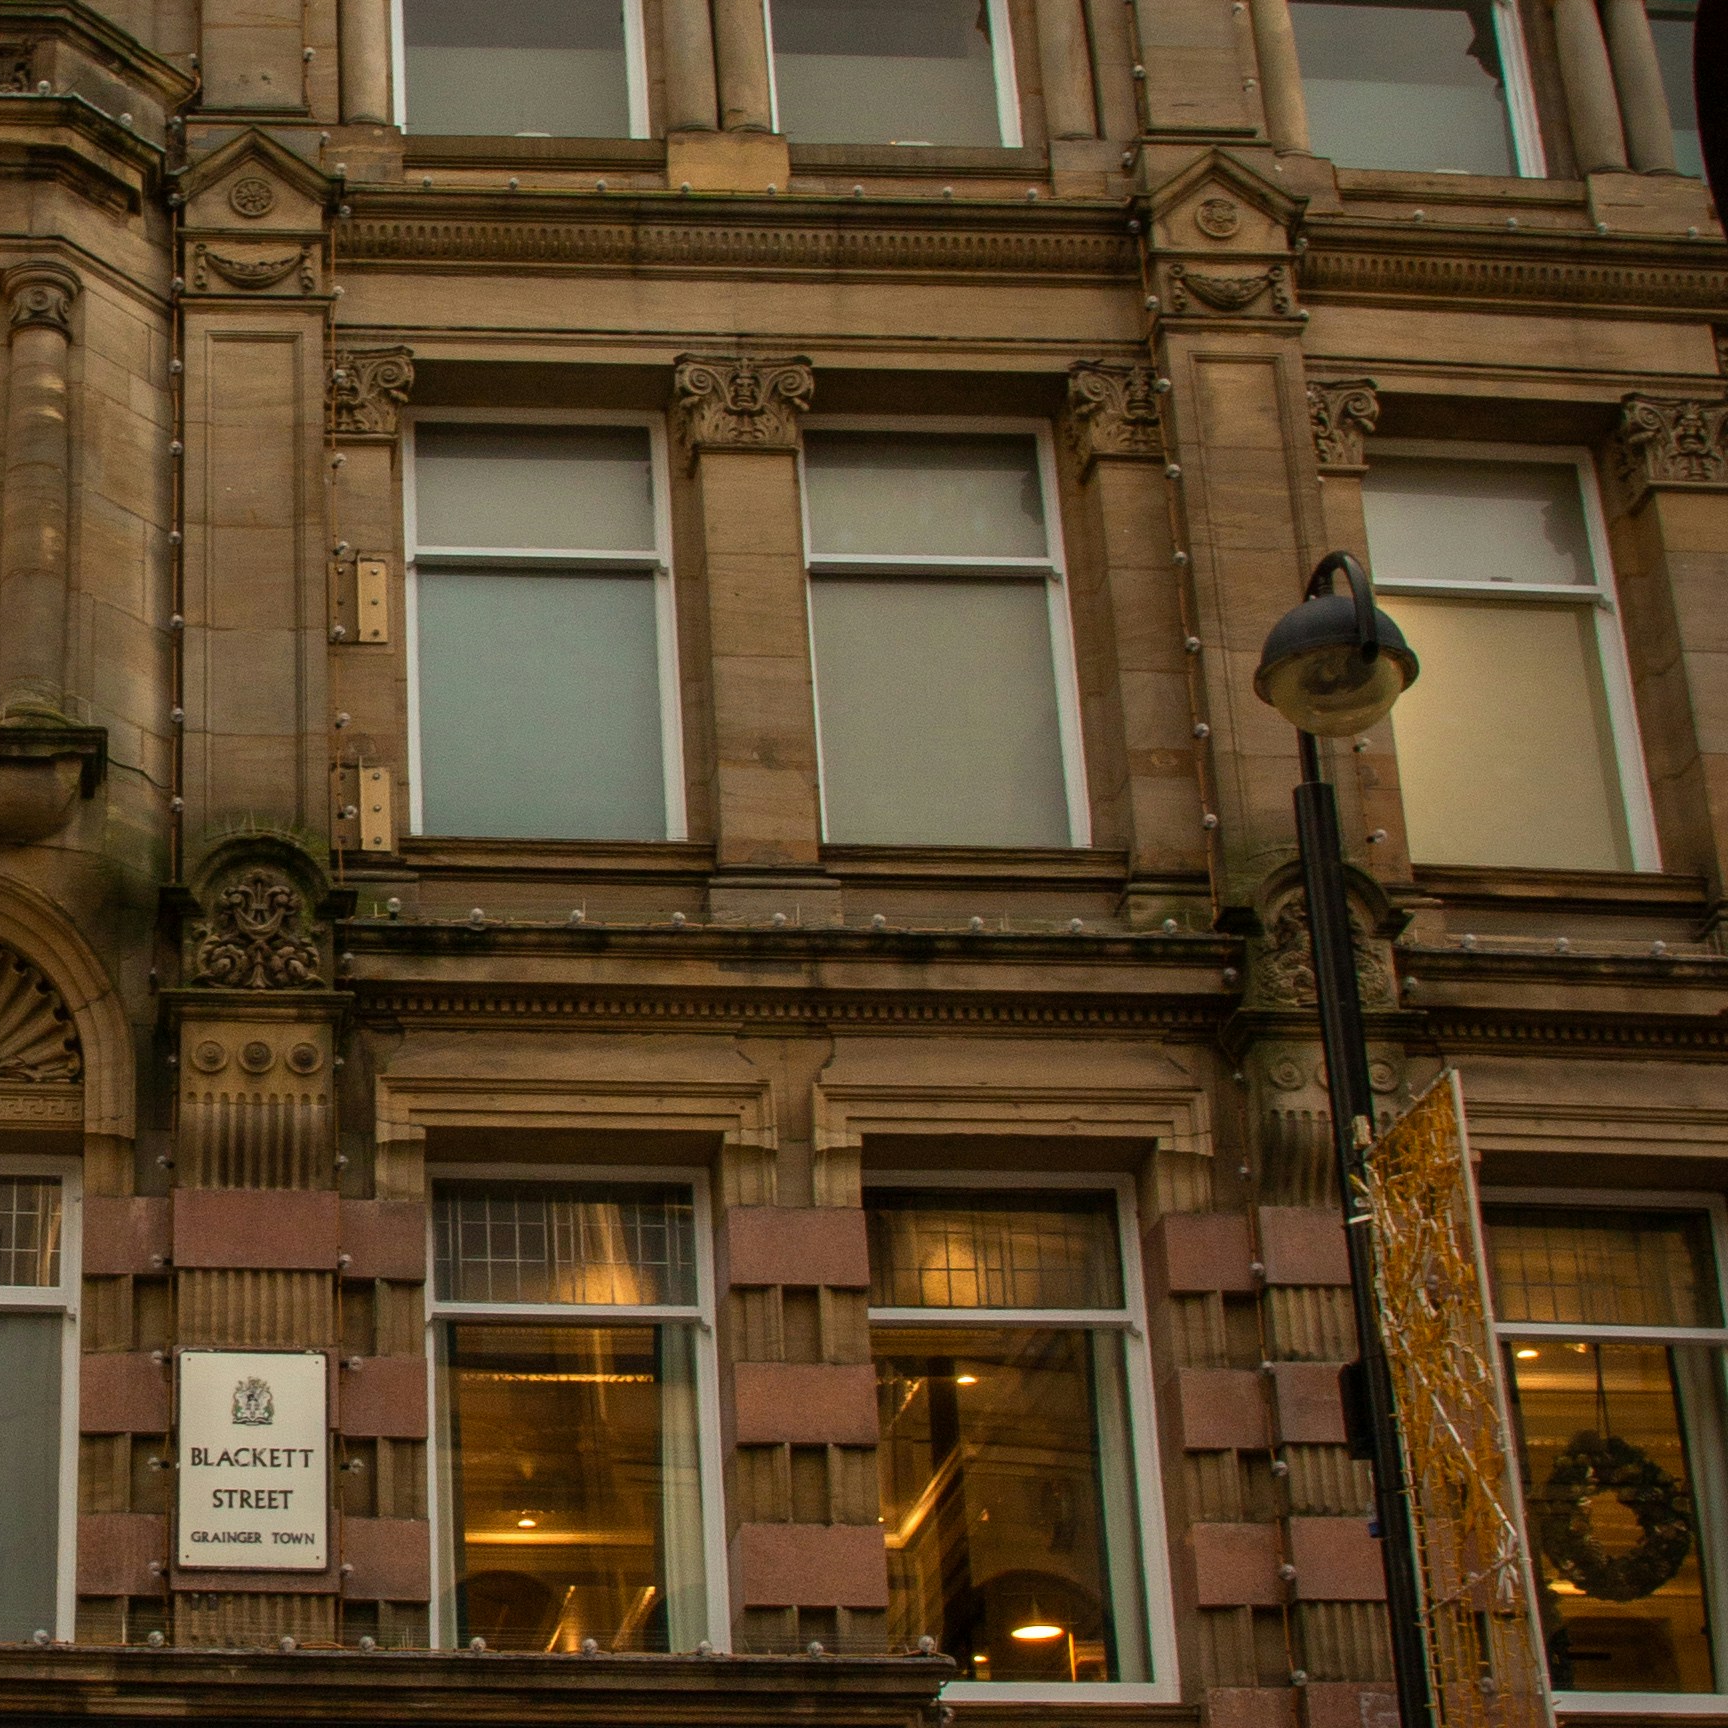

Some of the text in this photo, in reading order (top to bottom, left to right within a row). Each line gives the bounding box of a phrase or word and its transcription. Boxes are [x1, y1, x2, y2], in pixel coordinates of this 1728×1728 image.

[190, 1447, 315, 1468] BLACKETT
[212, 1489, 294, 1509] STREET
[191, 1531, 315, 1545] GRAINGER TOWN
